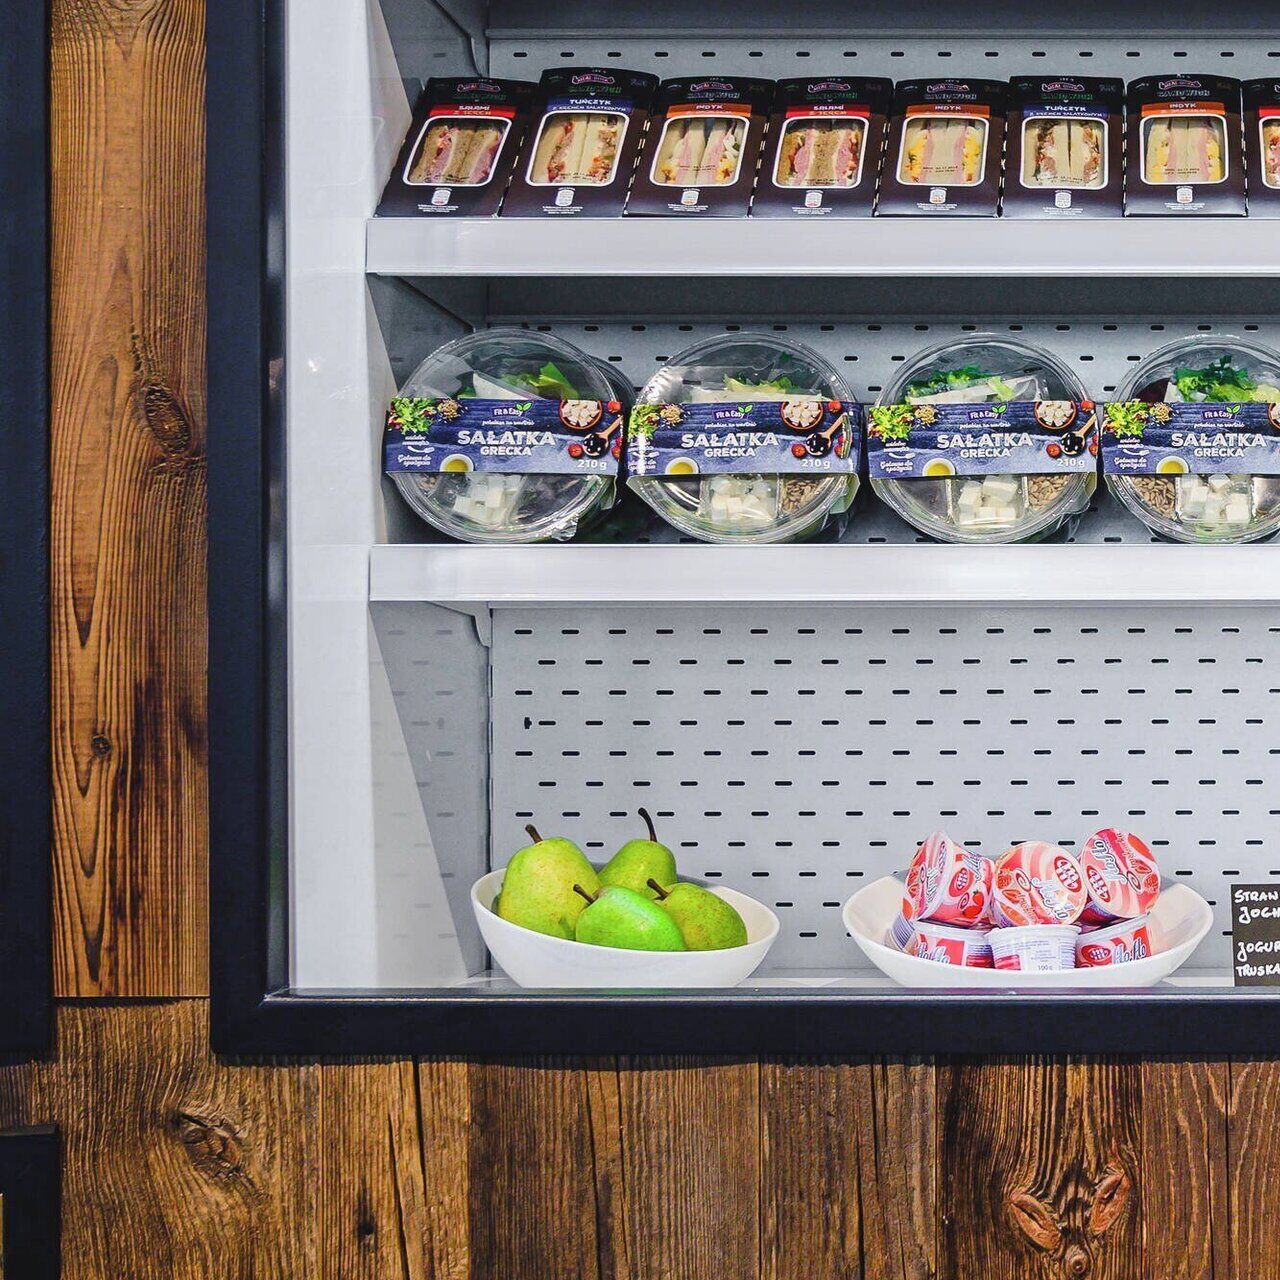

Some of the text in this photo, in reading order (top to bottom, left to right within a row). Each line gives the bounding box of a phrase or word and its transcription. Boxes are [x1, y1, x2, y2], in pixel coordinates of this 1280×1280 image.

[457, 430, 556, 446] SAŁATKA
[681, 432, 779, 448] SAŁATKA
[937, 432, 1034, 448] SAŁATKA
[1171, 433, 1267, 448] SAŁATKA
[480, 446, 532, 456] GRECKA
[704, 448, 755, 458] GRECKA
[960, 448, 1011, 458] GRECKA
[1194, 448, 1245, 457] GRECKA
[577, 459, 607, 471] 210 g
[801, 459, 831, 470] 210 g
[1057, 458, 1085, 469] 210 g
